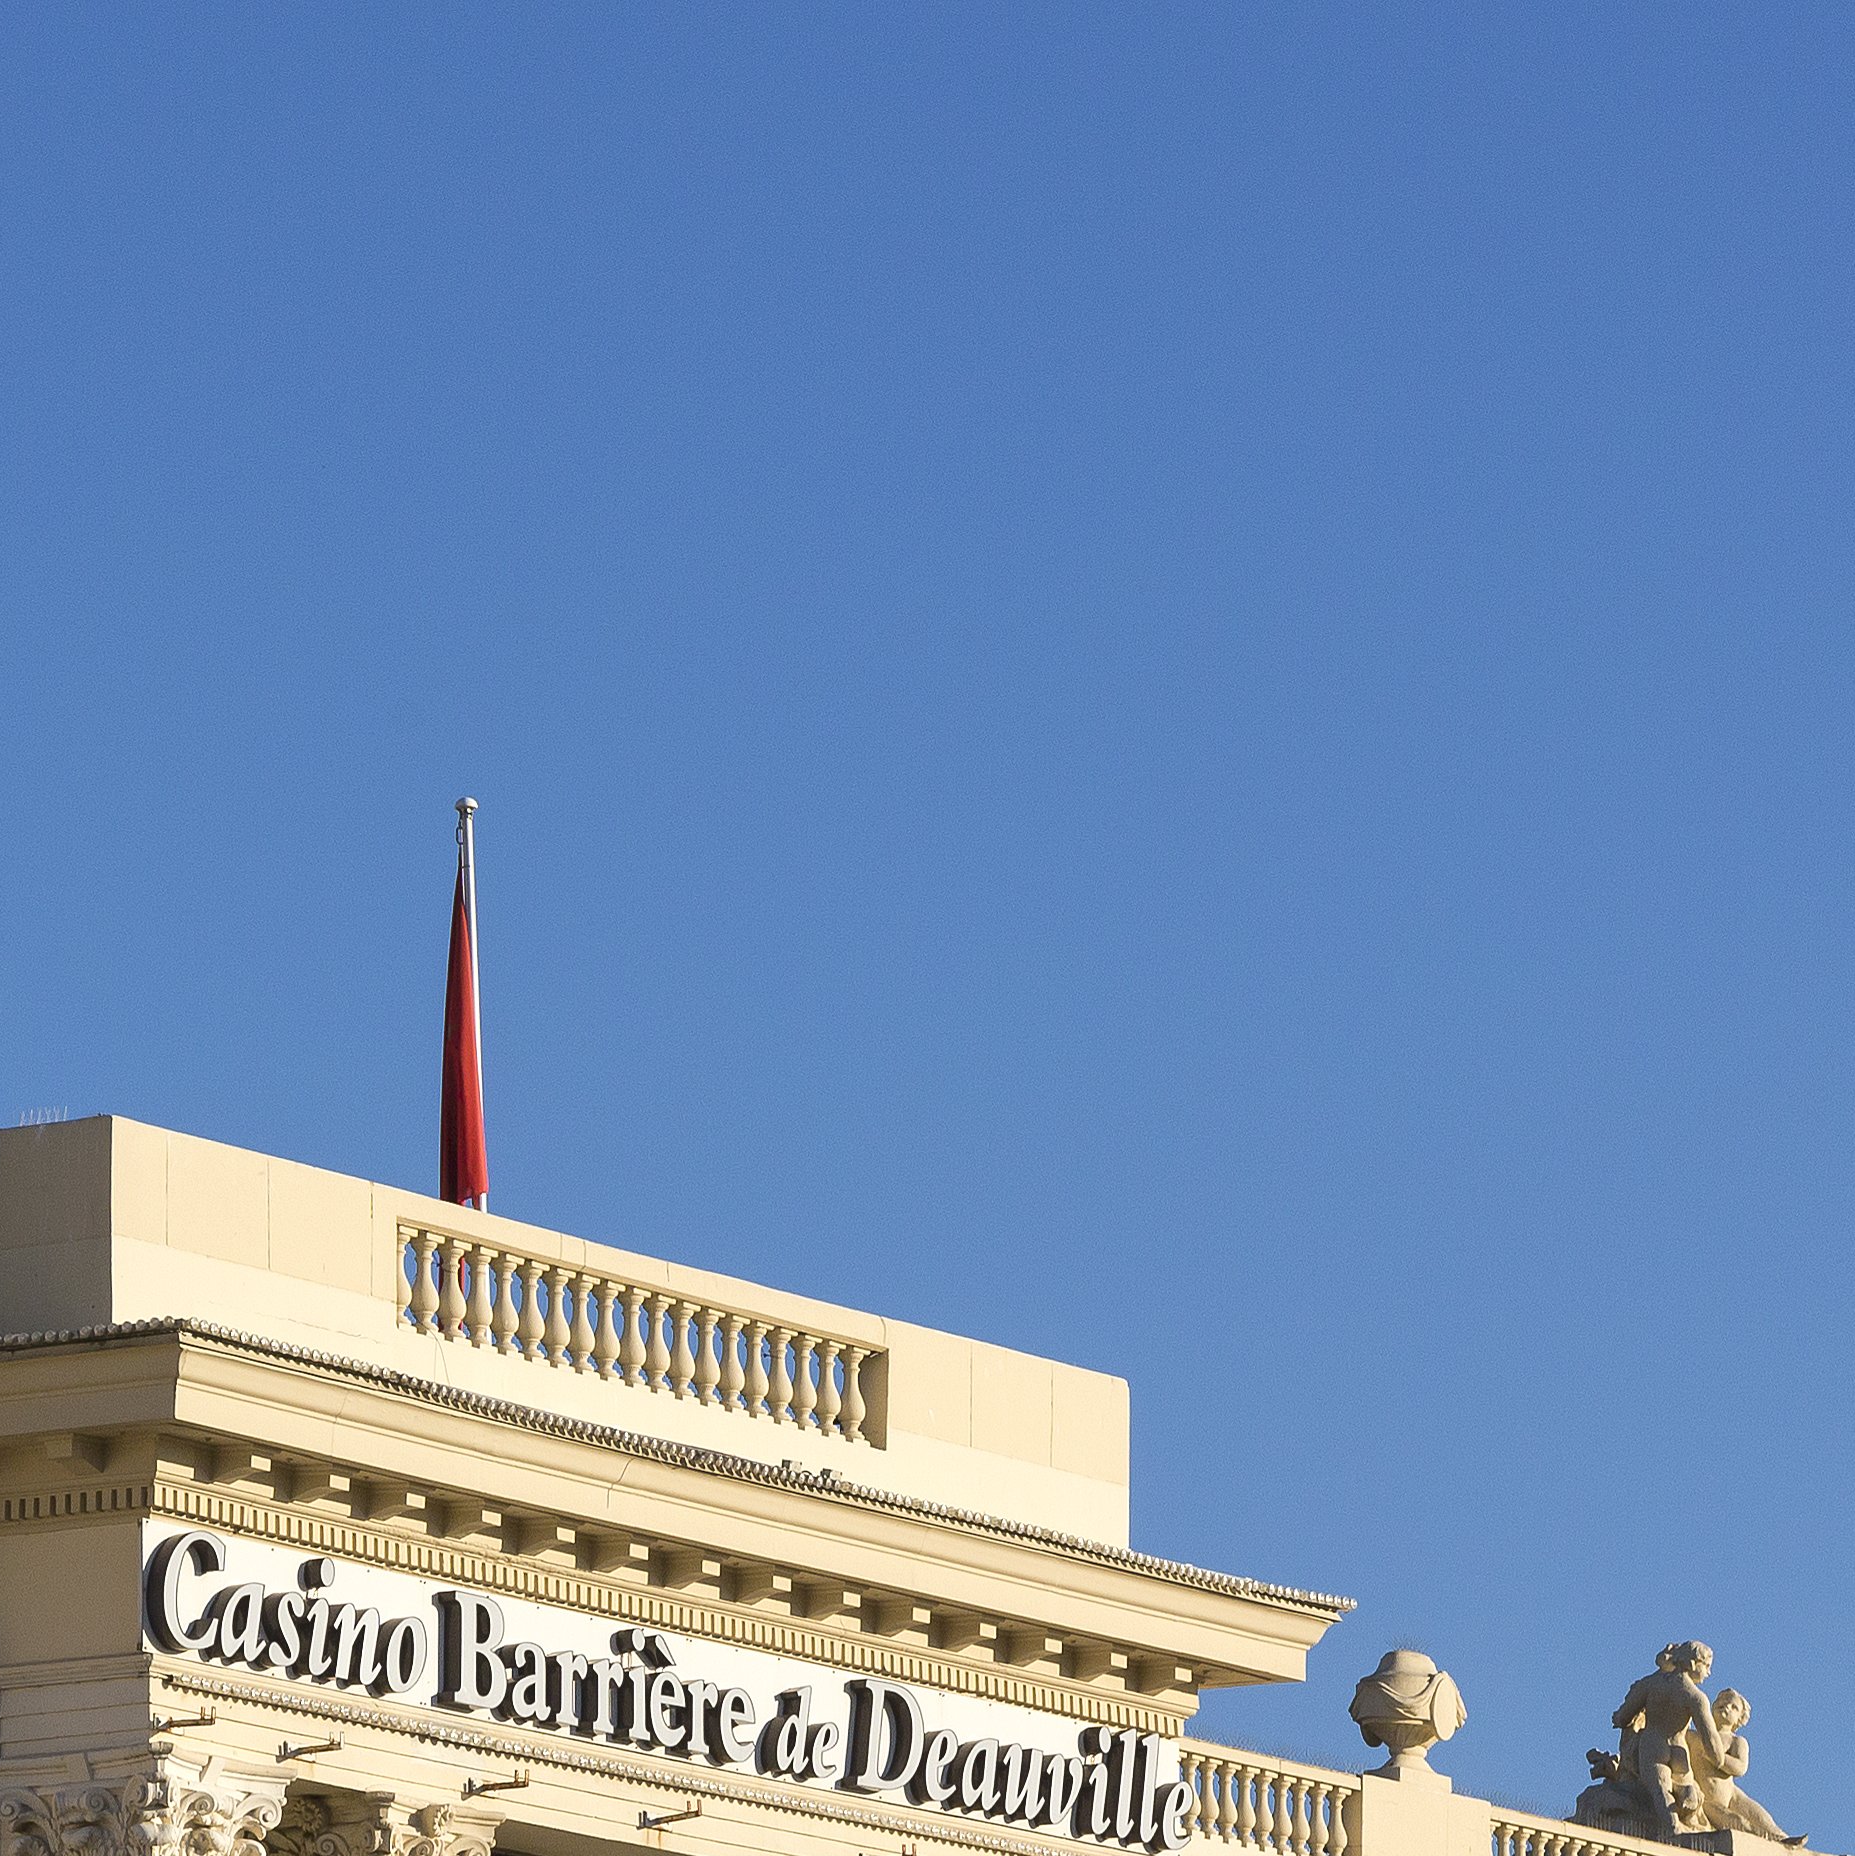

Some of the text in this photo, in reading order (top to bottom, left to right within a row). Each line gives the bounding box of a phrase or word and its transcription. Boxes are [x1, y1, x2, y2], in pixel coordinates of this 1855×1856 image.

[147, 1530, 1194, 1855] Casino Barrière de Deauville
